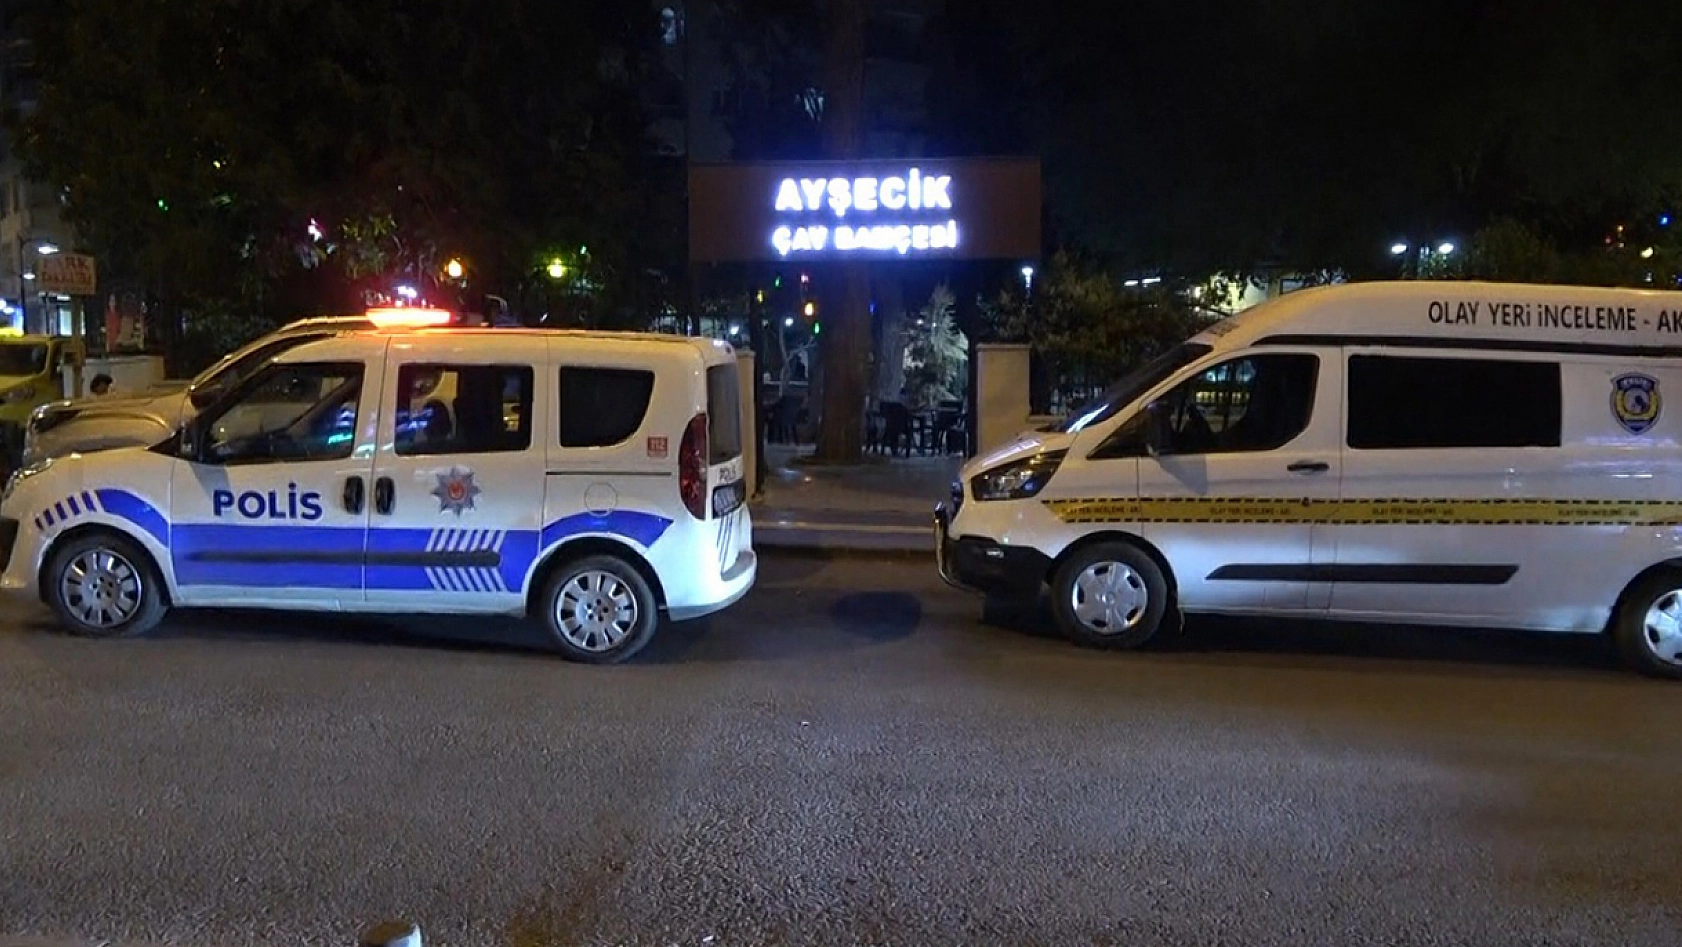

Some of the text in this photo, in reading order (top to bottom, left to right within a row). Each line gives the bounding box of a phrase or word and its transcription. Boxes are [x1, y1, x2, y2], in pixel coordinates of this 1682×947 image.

[774, 167, 953, 217] AYŞECİK
[772, 224, 828, 255] ÇAY
[1427, 300, 1480, 325] OLAY
[212, 481, 323, 520] POLİS
